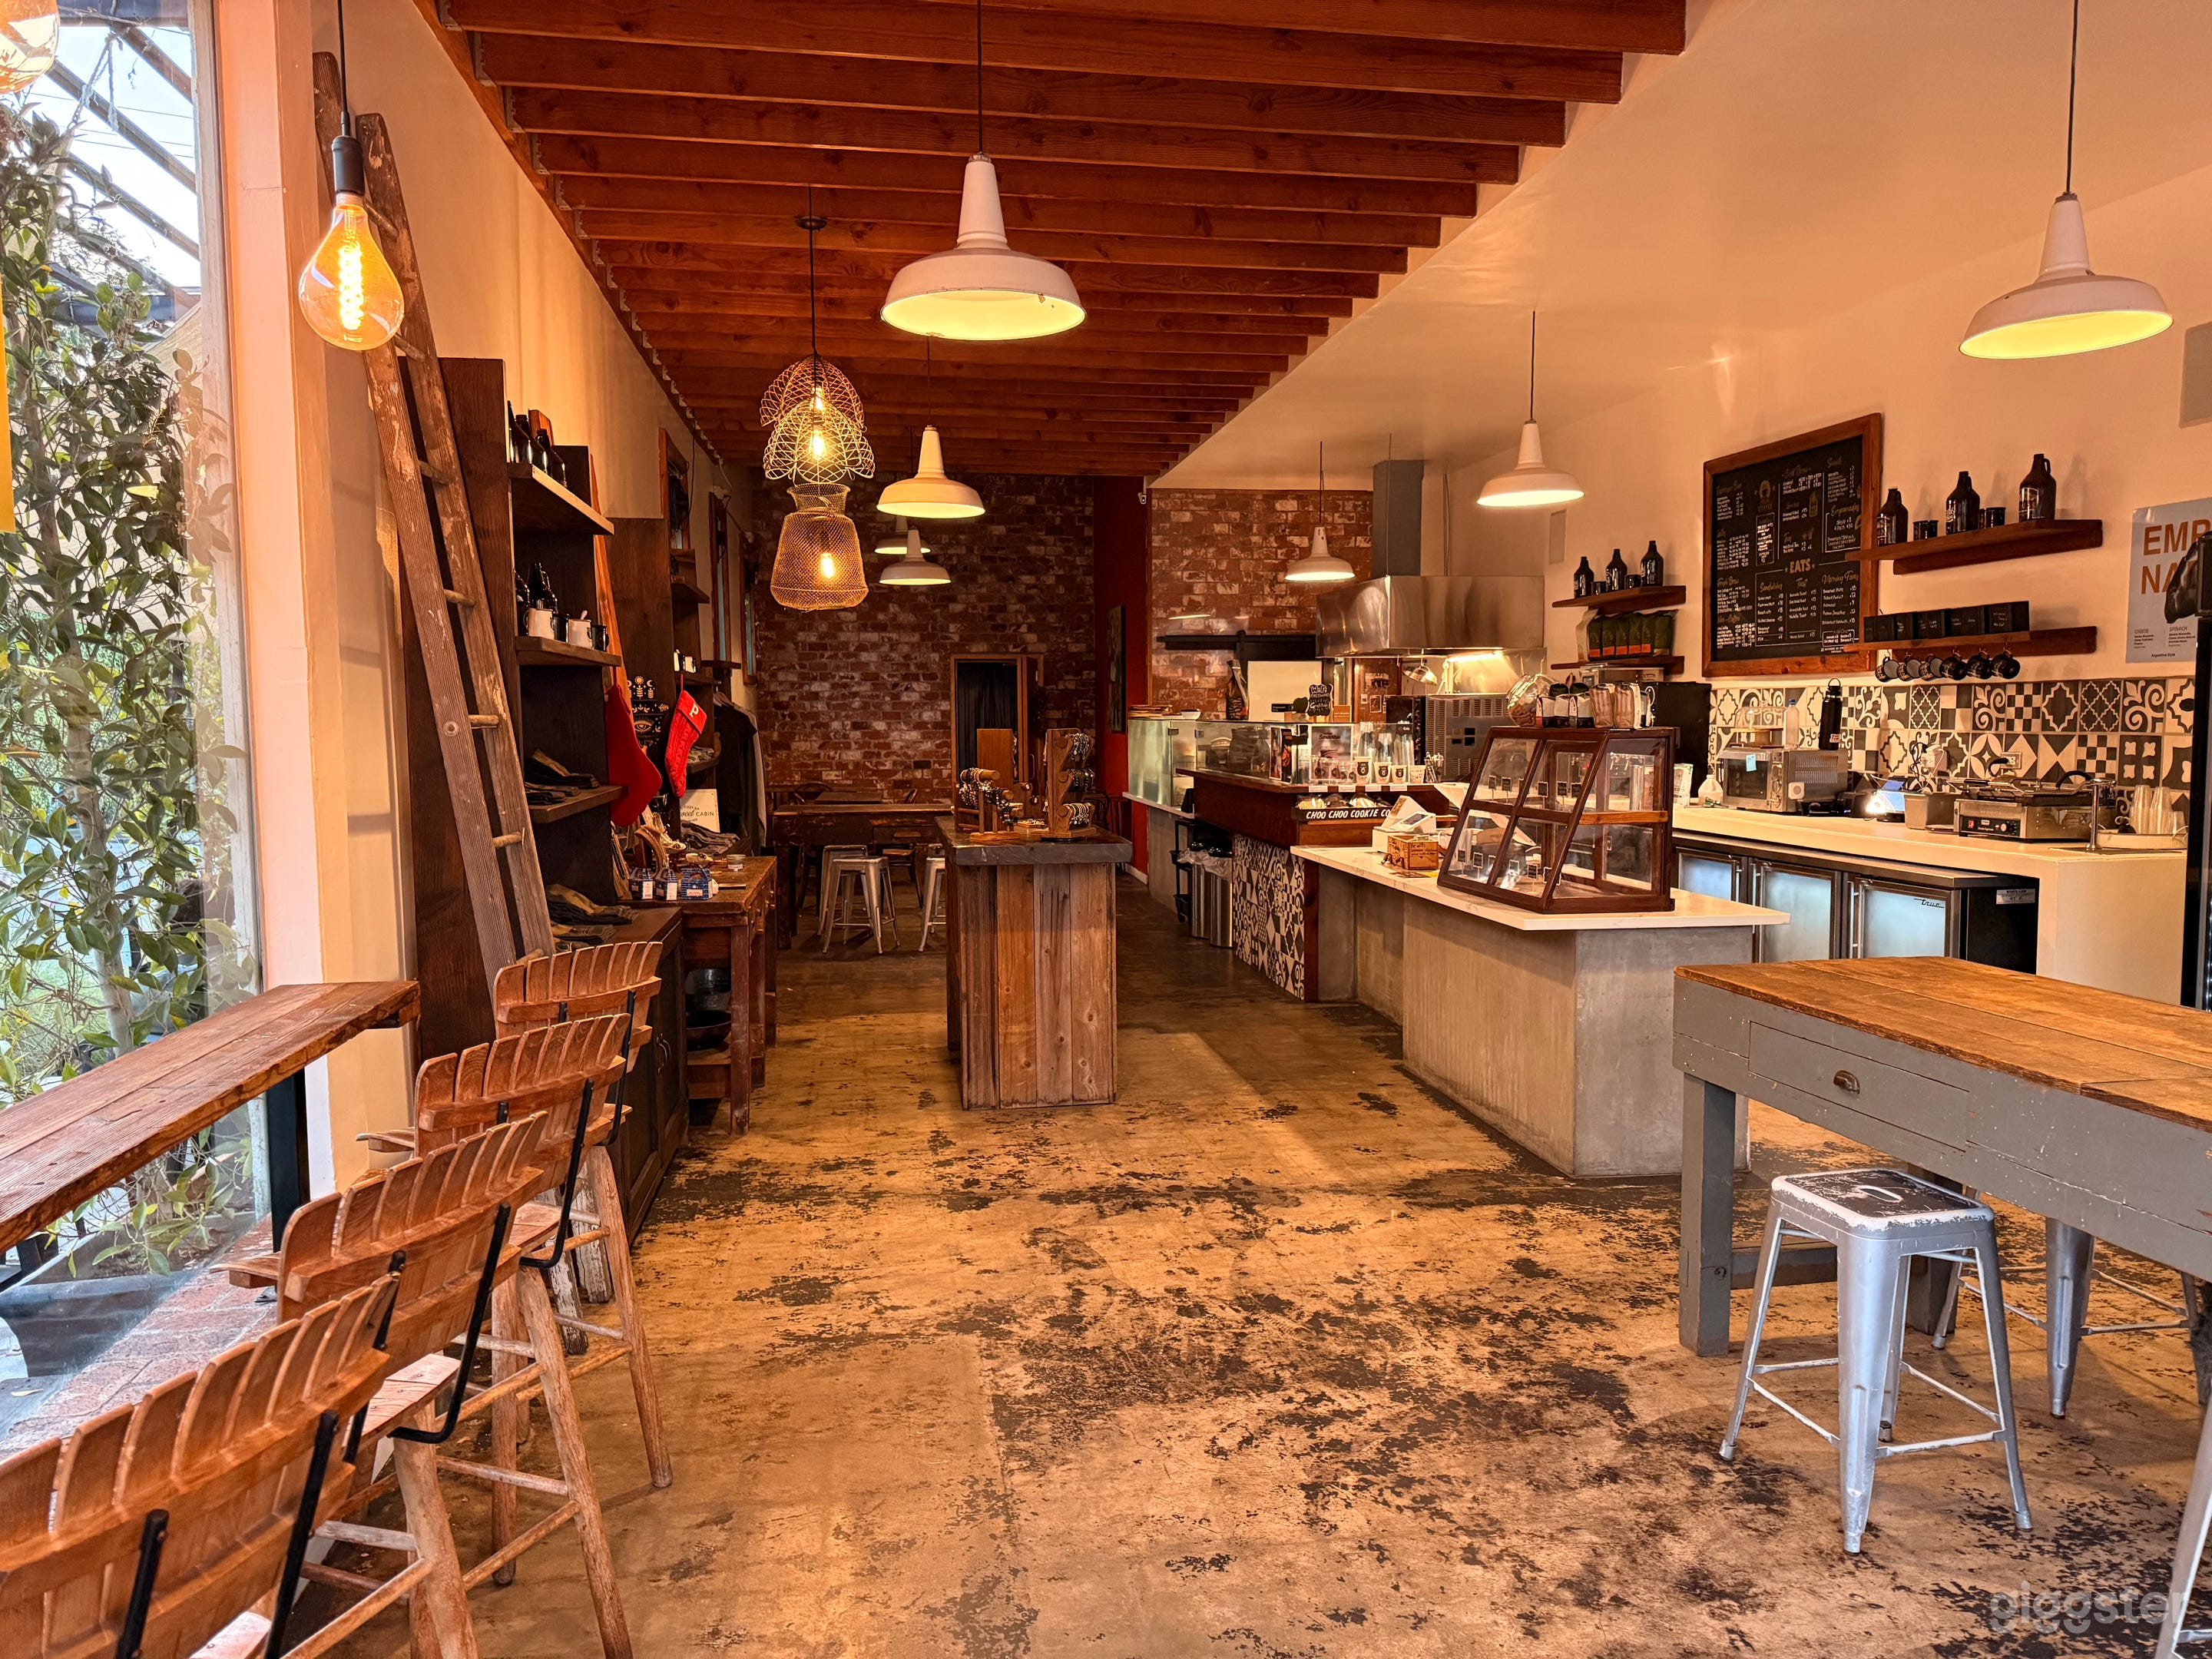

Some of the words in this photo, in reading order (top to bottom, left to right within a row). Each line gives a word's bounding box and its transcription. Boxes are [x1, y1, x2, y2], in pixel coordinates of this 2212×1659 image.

[1790, 558, 1811, 574] EATS
[689, 703, 699, 718] P
[1306, 811, 1326, 820] CHOO
[1328, 810, 1349, 819] CHOO
[1350, 809, 1379, 818] COOKIE
